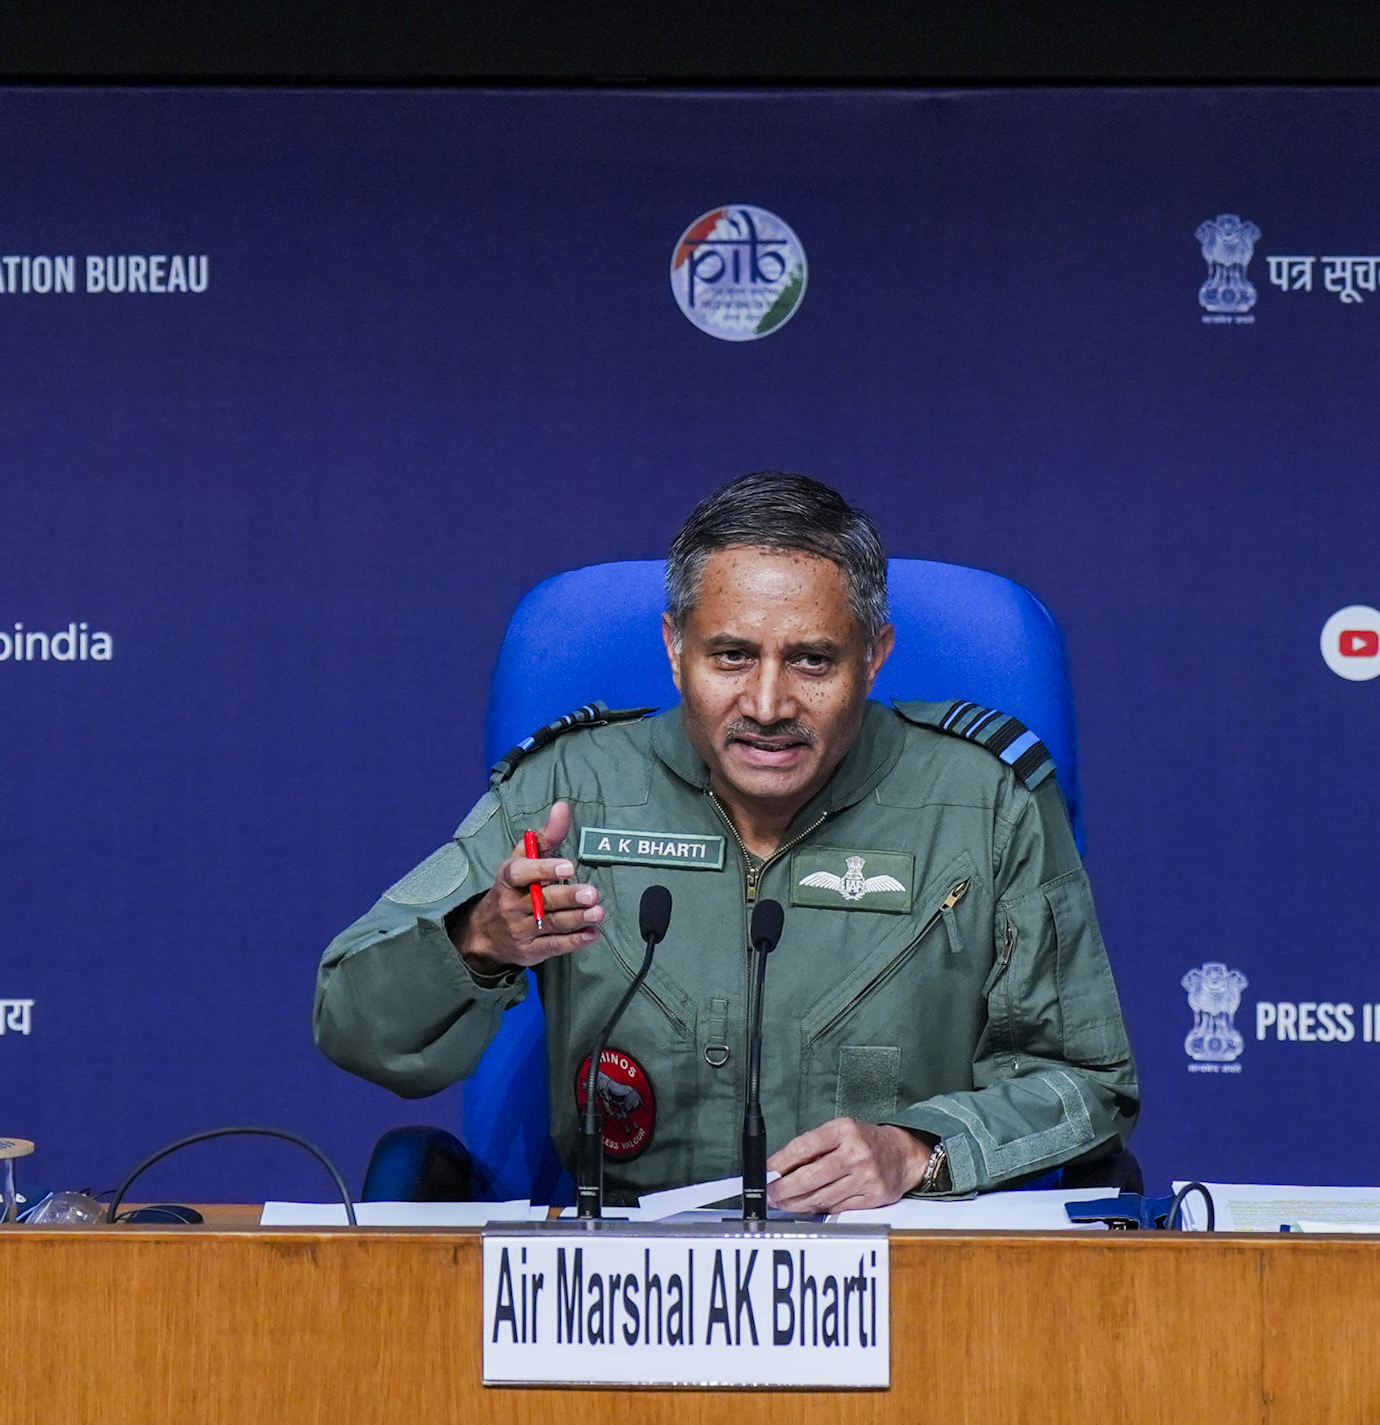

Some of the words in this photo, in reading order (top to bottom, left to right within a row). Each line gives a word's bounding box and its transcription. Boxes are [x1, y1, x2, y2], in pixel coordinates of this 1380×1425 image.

[86, 255, 208, 293] BUREAU
[1267, 254, 1313, 292] पत्र
[597, 837, 611, 852] A
[618, 838, 631, 854] K
[637, 839, 707, 860] BHARTI
[1256, 1002, 1355, 1042] PRESS
[492, 1246, 545, 1344] Air
[556, 1247, 694, 1347] Marshal
[706, 1248, 760, 1346] AK
[772, 1249, 877, 1348] Bharti
